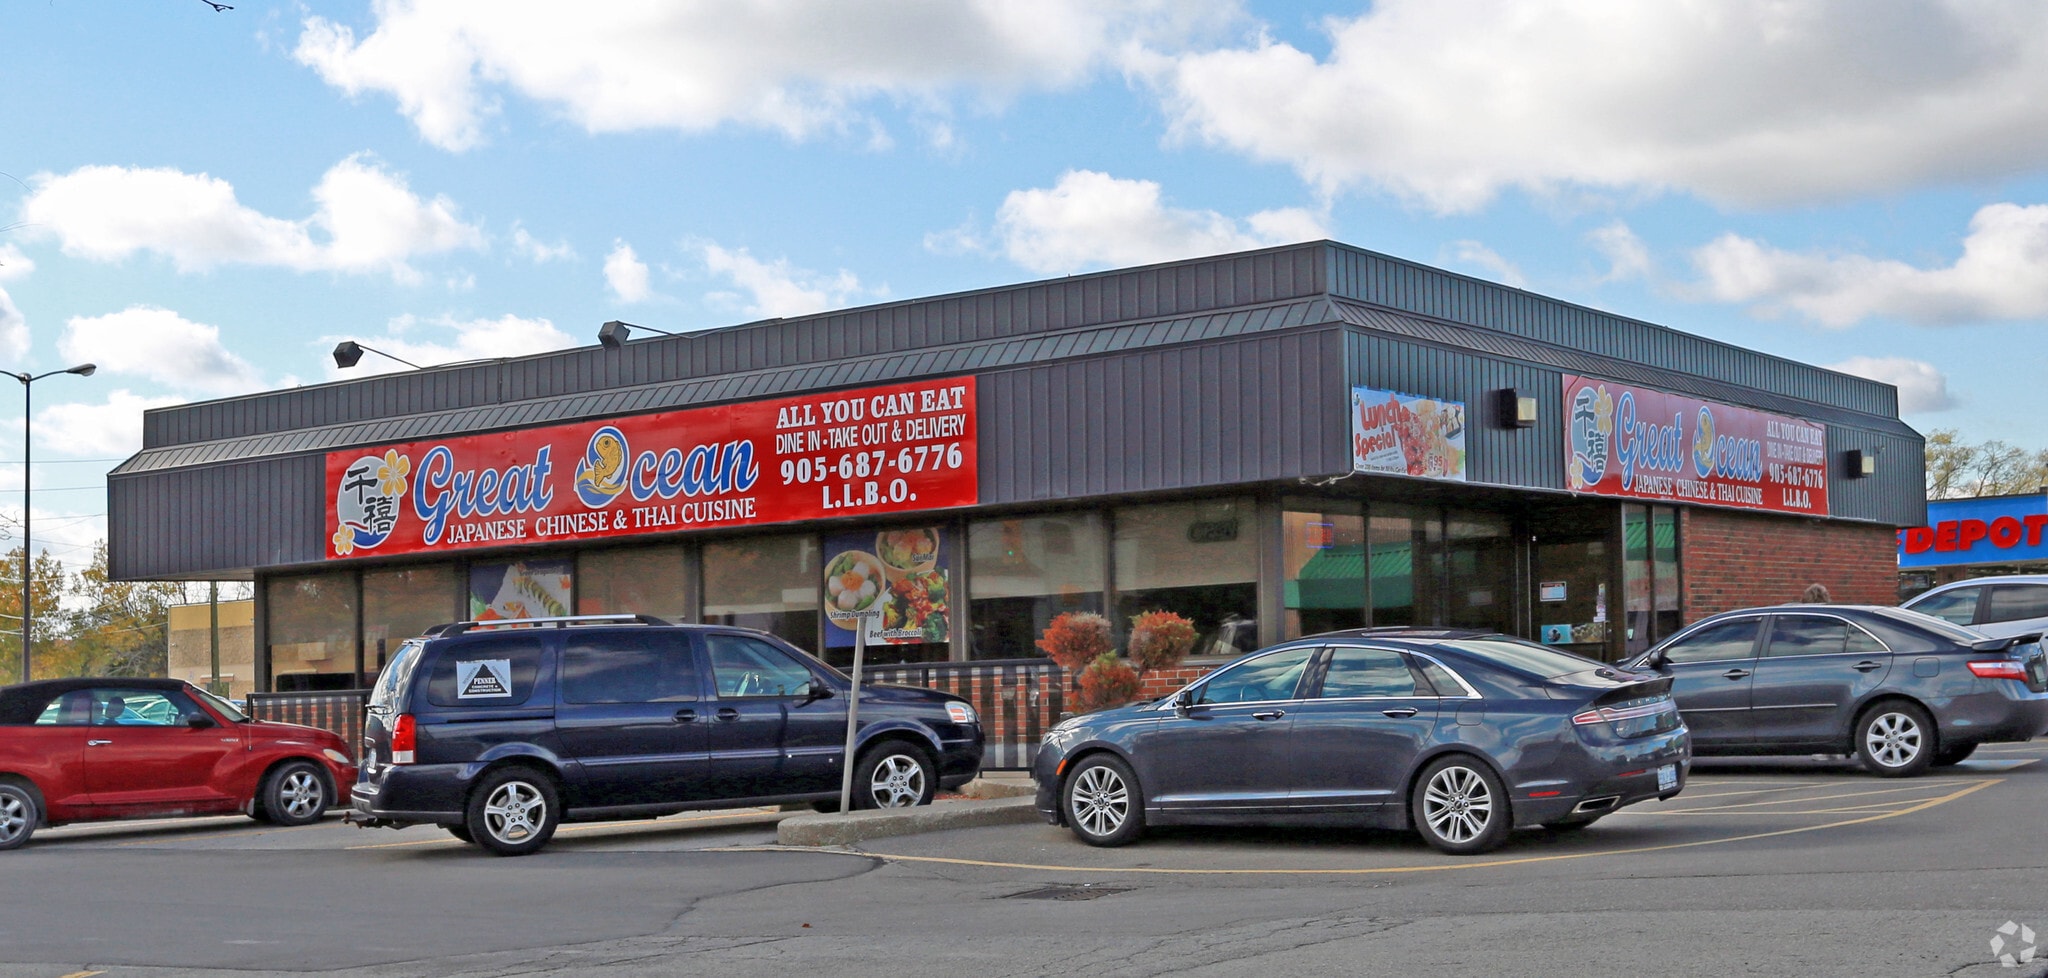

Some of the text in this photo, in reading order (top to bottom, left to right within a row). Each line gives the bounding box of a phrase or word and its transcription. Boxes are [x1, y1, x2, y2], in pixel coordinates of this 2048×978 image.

[776, 385, 966, 429] ALL YOU CAN EAT
[1360, 393, 1402, 431] Lunch
[776, 431, 804, 455] DINE
[861, 422, 888, 446] OUT
[891, 419, 902, 443] &
[906, 413, 967, 441] DELIVERY
[1354, 423, 1397, 461] Special
[1615, 391, 1685, 491] Great
[1766, 420, 1780, 439] ALL
[1780, 422, 1796, 441] YOU
[1796, 425, 1809, 444] CAN
[780, 442, 963, 486] 905-687-6776
[1769, 462, 1824, 489] 905-687-6776
[413, 443, 554, 546] Great
[822, 478, 917, 509] L.L.B.O.
[1634, 474, 1764, 505] JAPANESE CHINESE & THAI CUISINE
[446, 497, 757, 544] JAPANESE CHINESE & THAI CUISINE
[1904, 514, 2048, 554] DEPOT
[830, 610, 880, 619] Shrimp Dumpling
[869, 628, 922, 638] Beef with Broccoli
